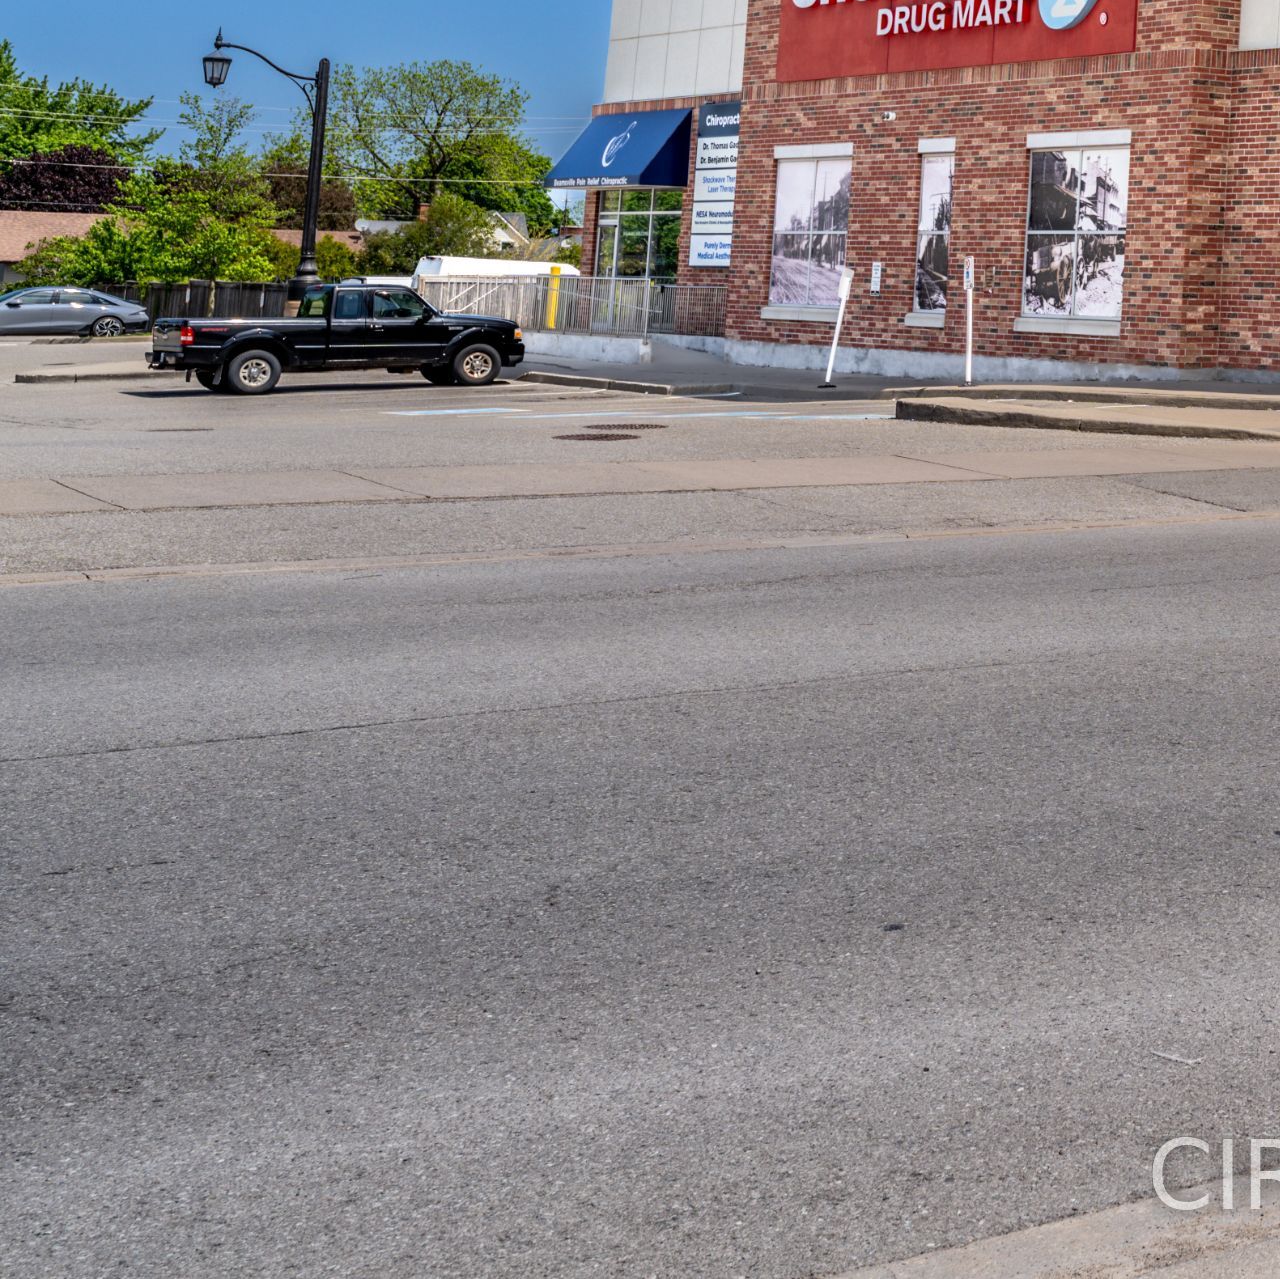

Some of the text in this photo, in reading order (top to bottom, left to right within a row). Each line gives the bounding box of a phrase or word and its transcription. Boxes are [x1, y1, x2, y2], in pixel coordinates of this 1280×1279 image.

[876, 1, 946, 36] DRUG
[710, 141, 729, 150] Thomas
[708, 155, 729, 165] Benjamin
[553, 178, 575, 187] Beamsville
[587, 176, 600, 186] Relief
[600, 176, 628, 185] Chiropractic
[704, 241, 719, 250] Purely
[698, 251, 715, 260] Medical
